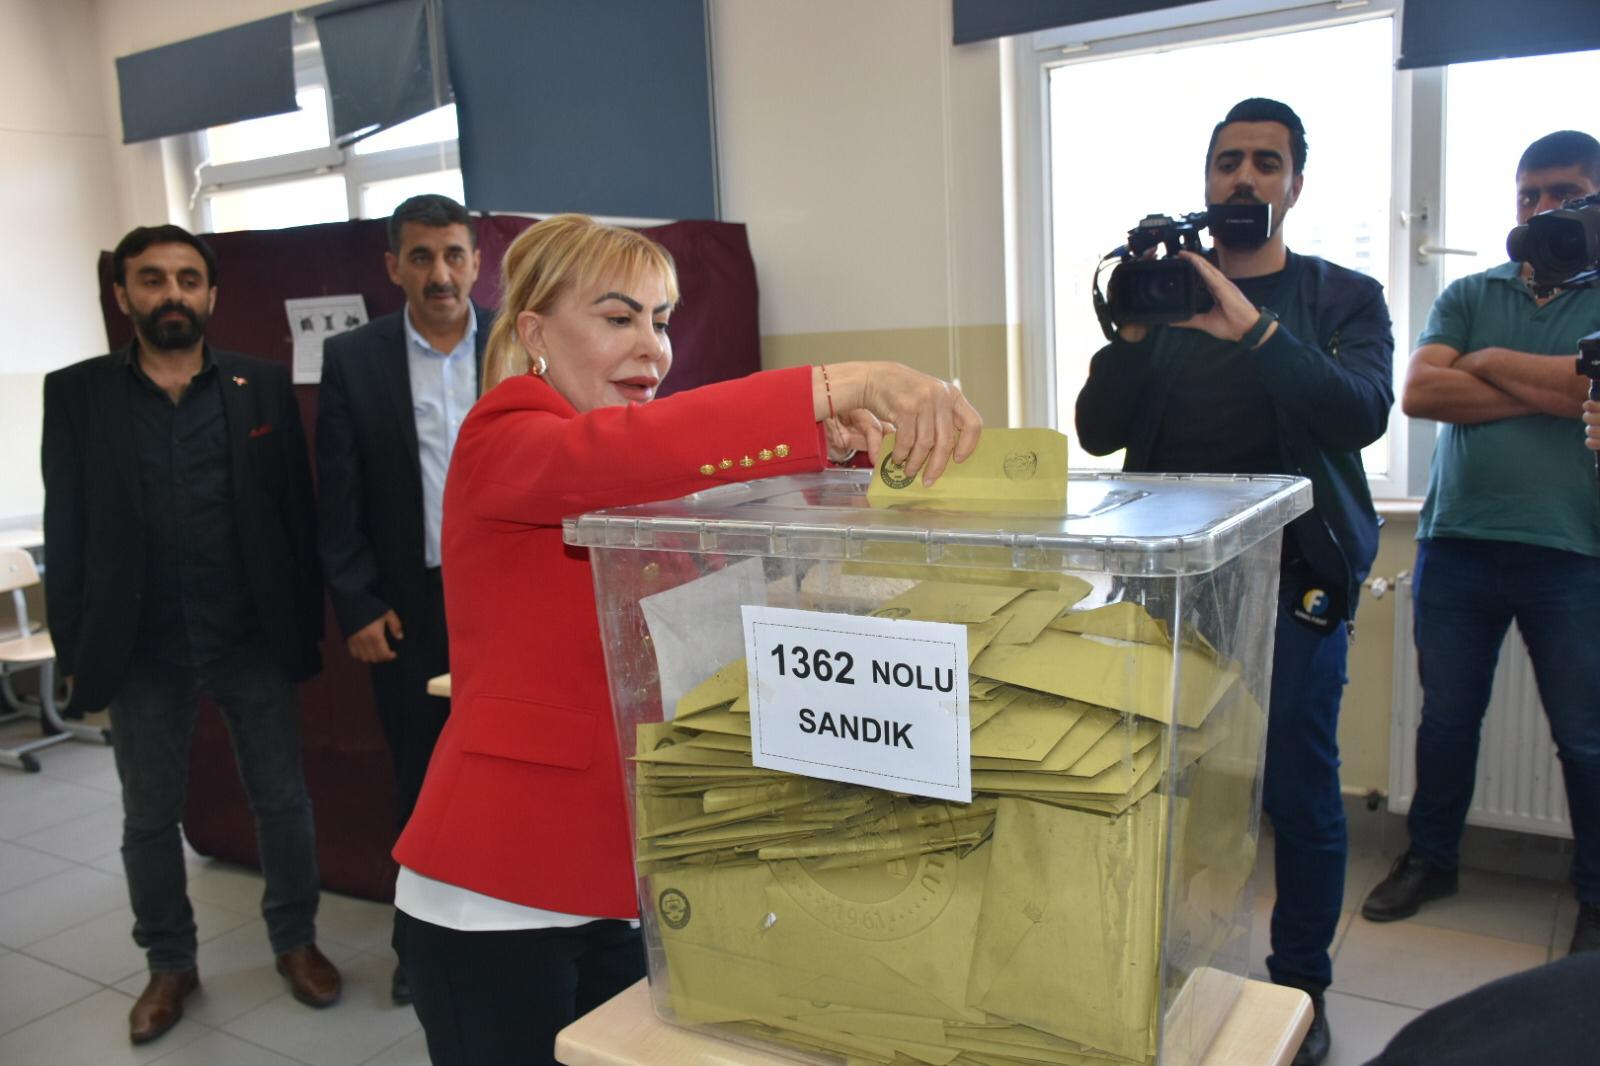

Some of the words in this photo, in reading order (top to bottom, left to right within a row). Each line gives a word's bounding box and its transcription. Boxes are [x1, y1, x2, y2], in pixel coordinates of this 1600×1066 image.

[771, 643, 855, 685] 1362
[872, 659, 954, 692] NOLU
[798, 708, 914, 749] SANDIK
